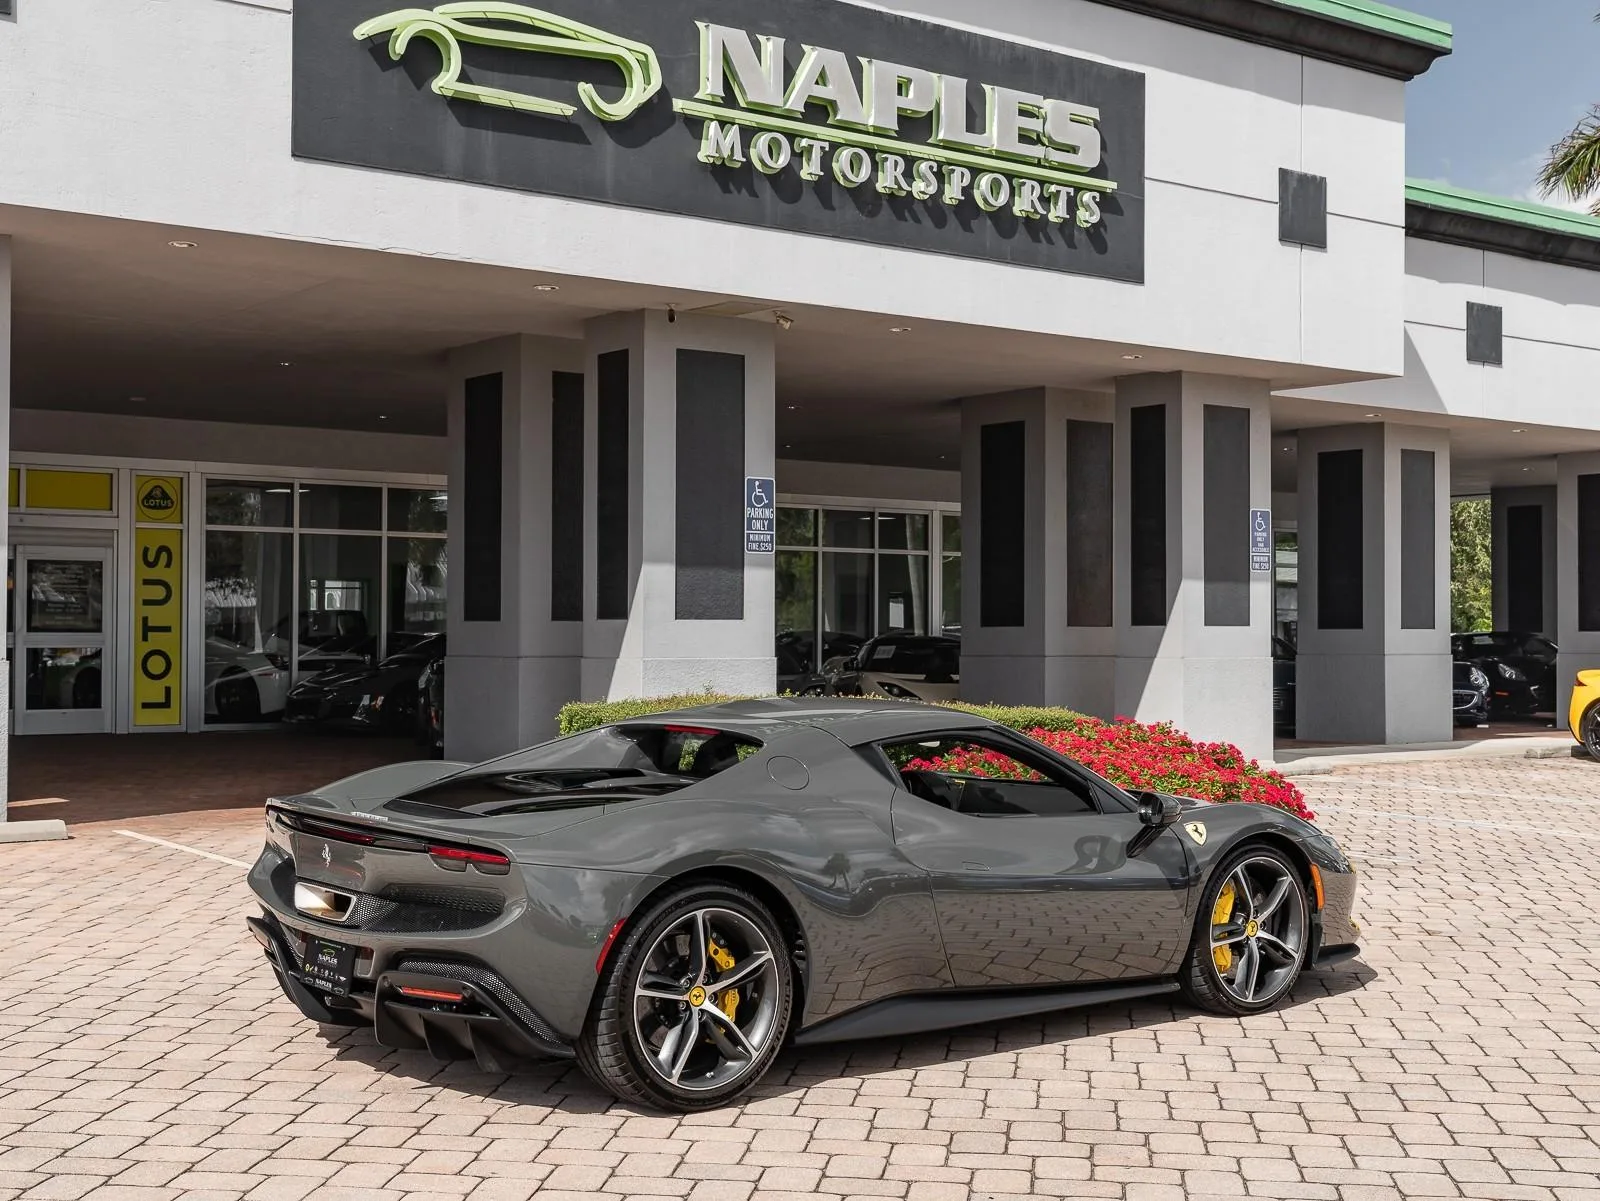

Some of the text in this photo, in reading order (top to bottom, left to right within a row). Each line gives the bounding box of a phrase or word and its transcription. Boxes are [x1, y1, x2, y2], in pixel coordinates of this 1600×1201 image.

[695, 20, 1101, 172] NAPLES
[697, 119, 1101, 228] MOTORSPORTS
[144, 499, 173, 508] LOTUS
[747, 507, 773, 519] PARKING
[752, 519, 768, 530] ONLY
[750, 533, 771, 541] MINIMUM
[748, 542, 759, 551] FINE
[141, 545, 173, 709] LOTUS
